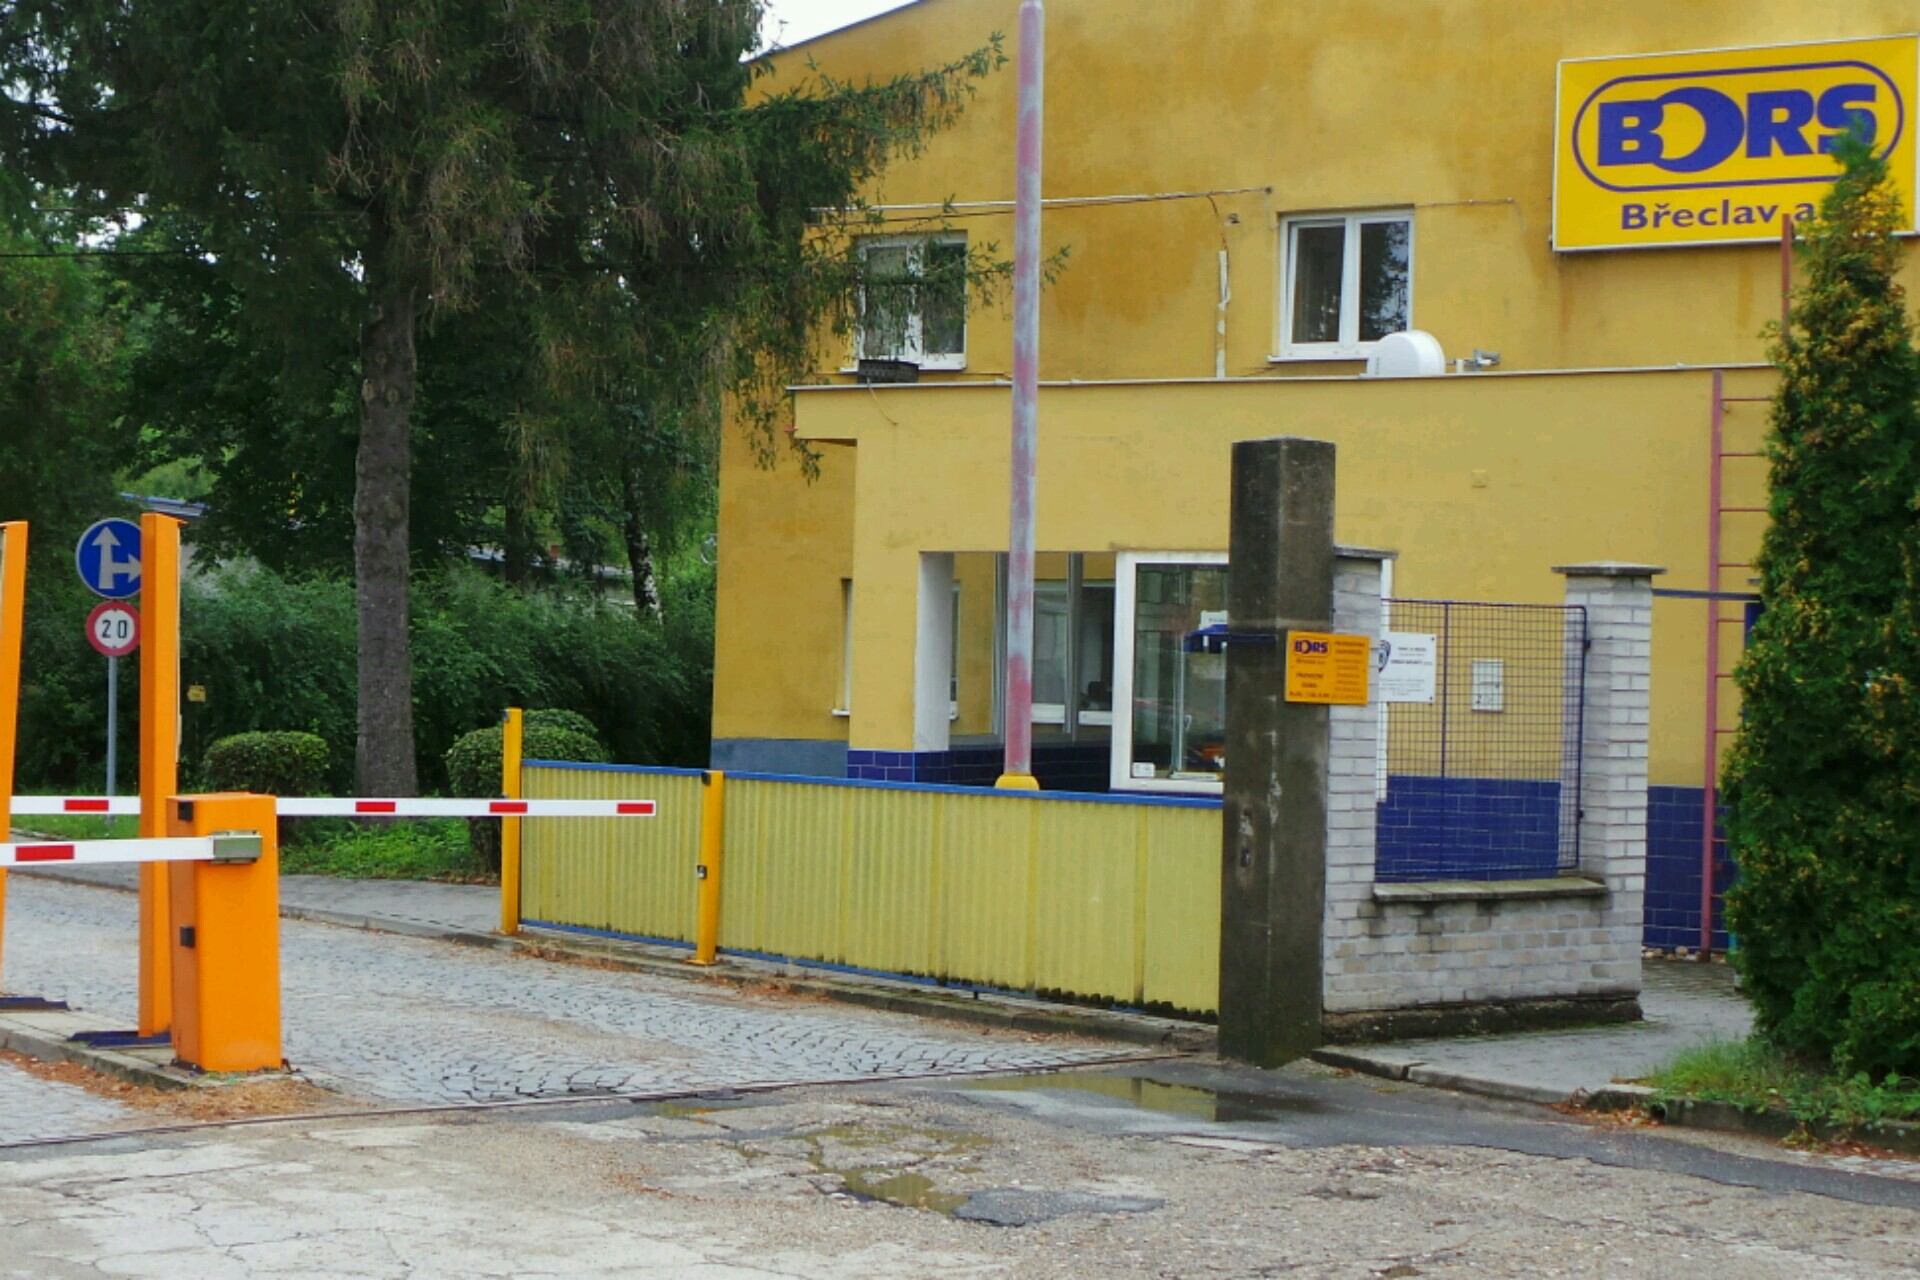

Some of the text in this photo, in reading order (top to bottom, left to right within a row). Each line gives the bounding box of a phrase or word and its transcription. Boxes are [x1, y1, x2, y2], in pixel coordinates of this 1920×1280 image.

[1597, 83, 1876, 174] BORS
[1621, 199, 1778, 230] Břeclav
[102, 619, 127, 638] 20
